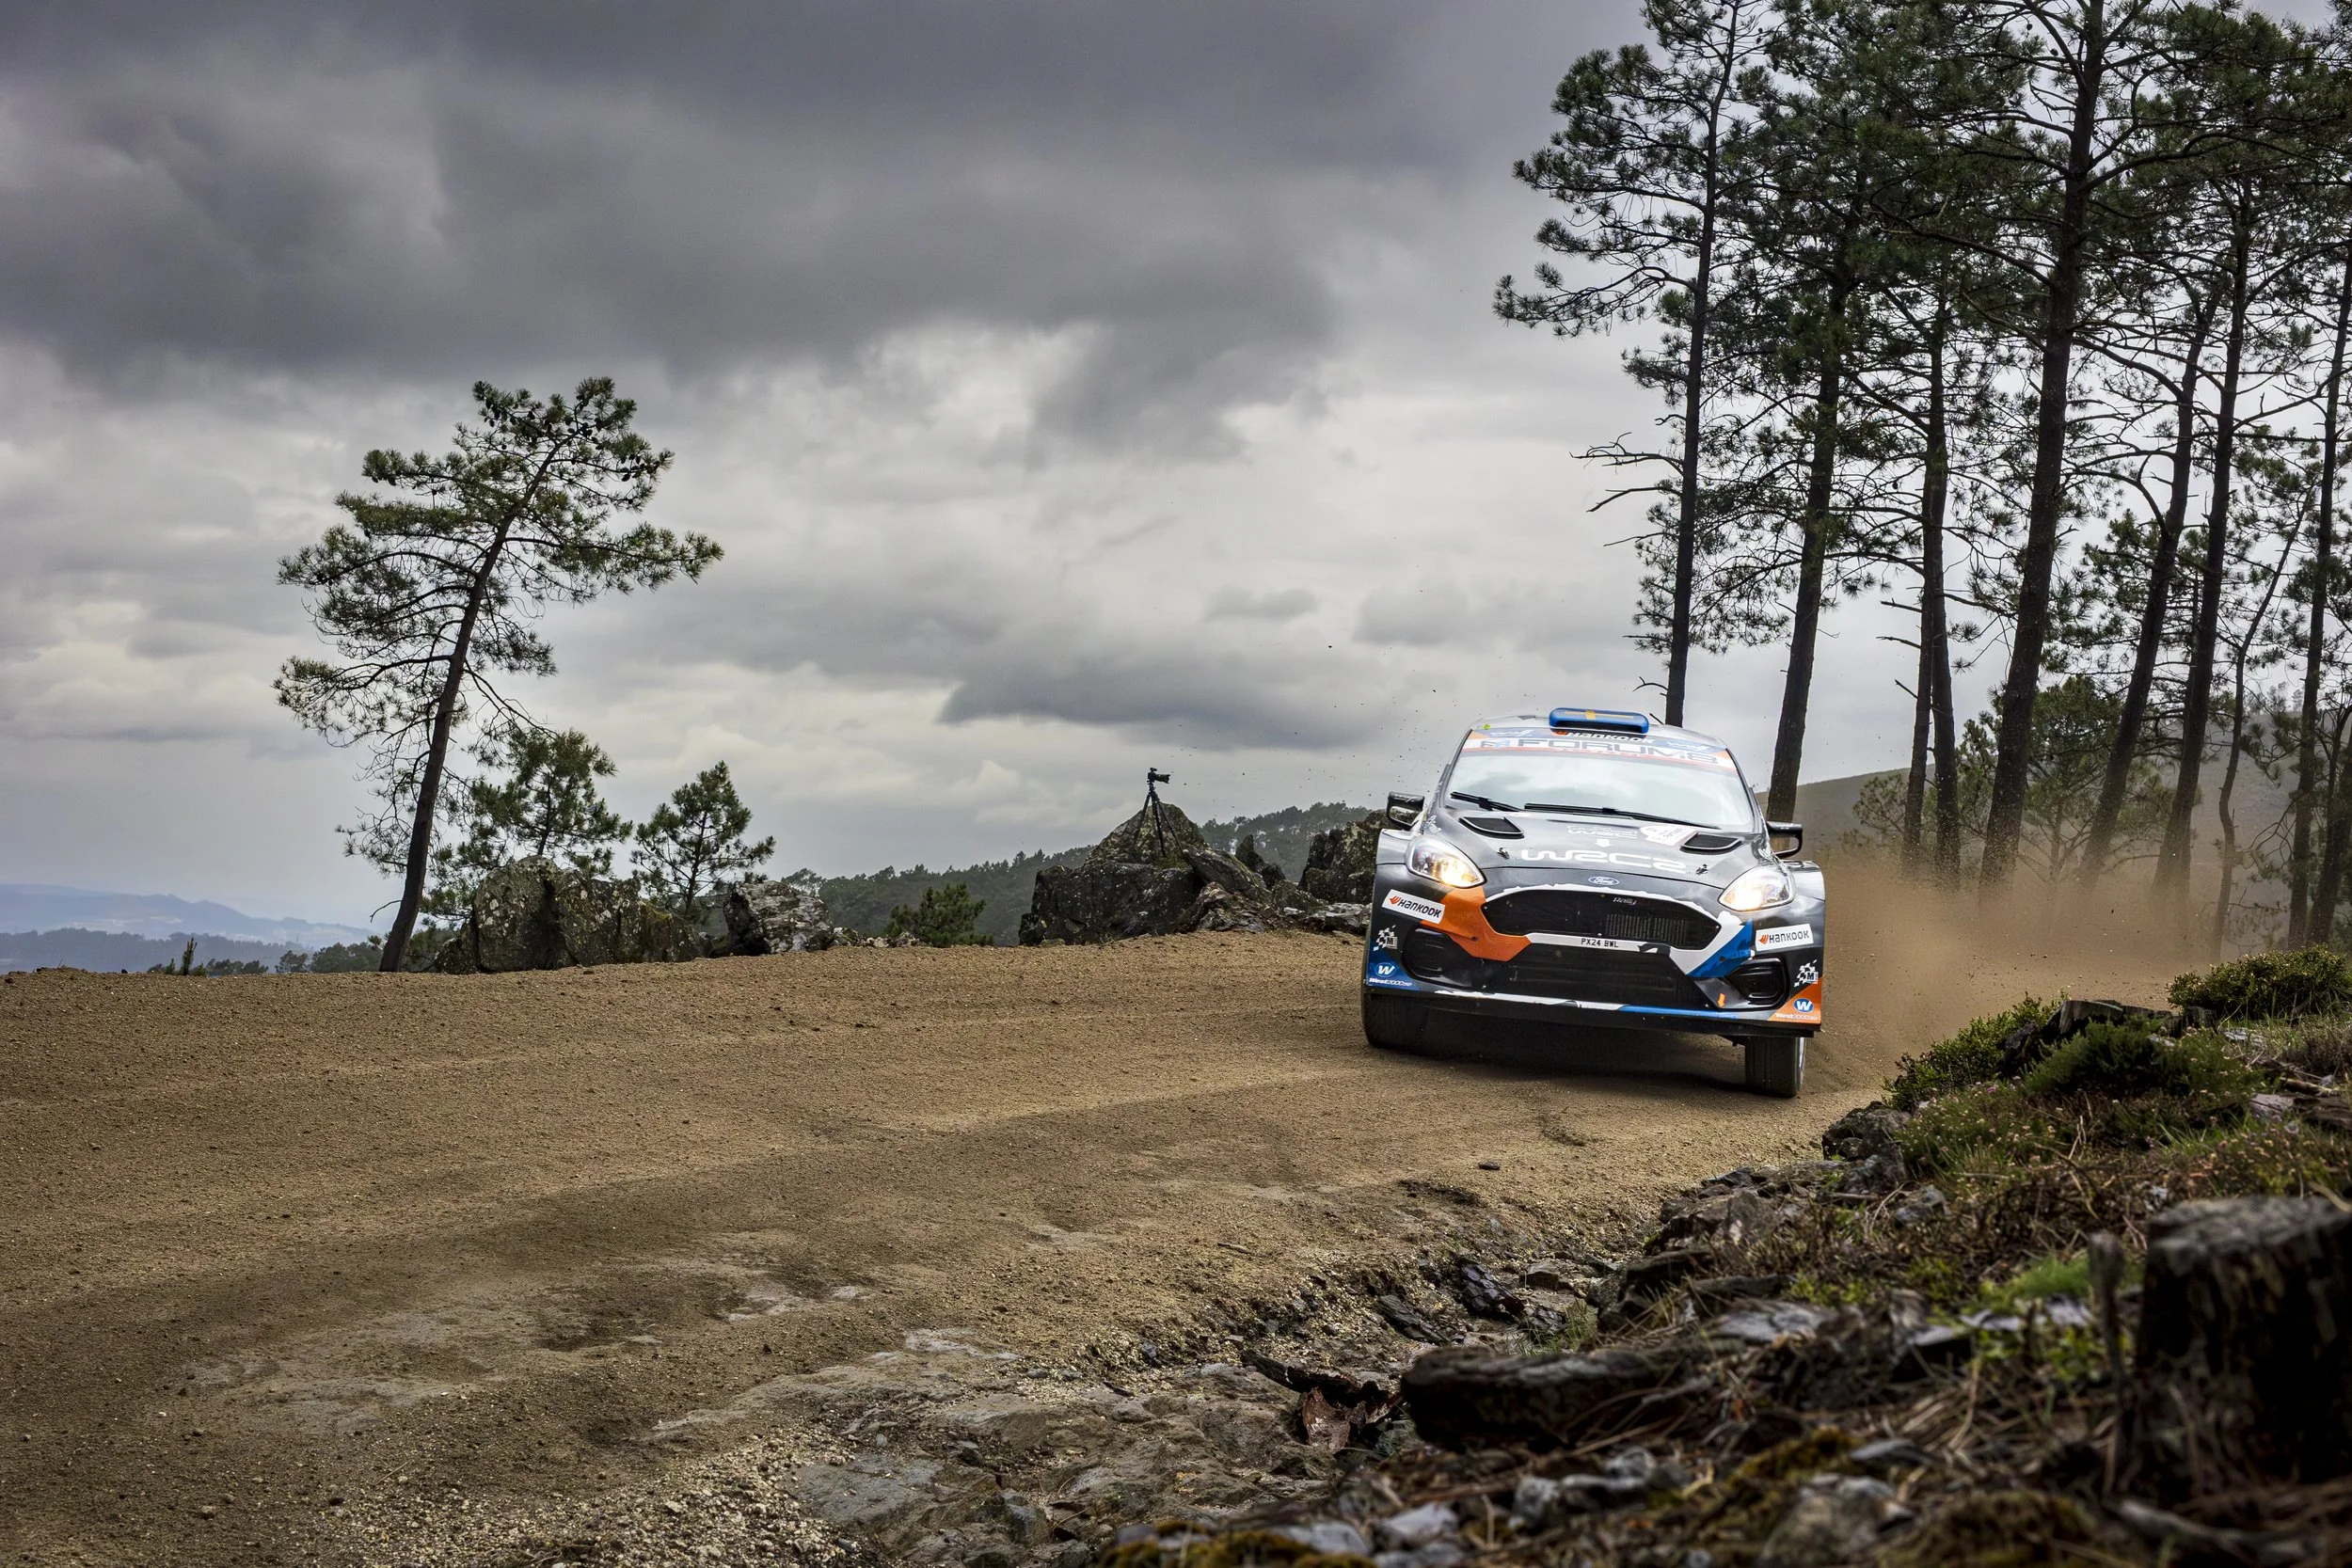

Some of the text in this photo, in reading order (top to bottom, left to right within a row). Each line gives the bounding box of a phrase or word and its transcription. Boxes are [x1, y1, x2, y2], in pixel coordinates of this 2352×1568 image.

[1518, 739, 1719, 764] FORUM8
[1520, 849, 1687, 875] WRC2
[1581, 938, 1619, 948] PX24 BWL
[1377, 965, 1395, 975] W
[1796, 1000, 1813, 1011] W
